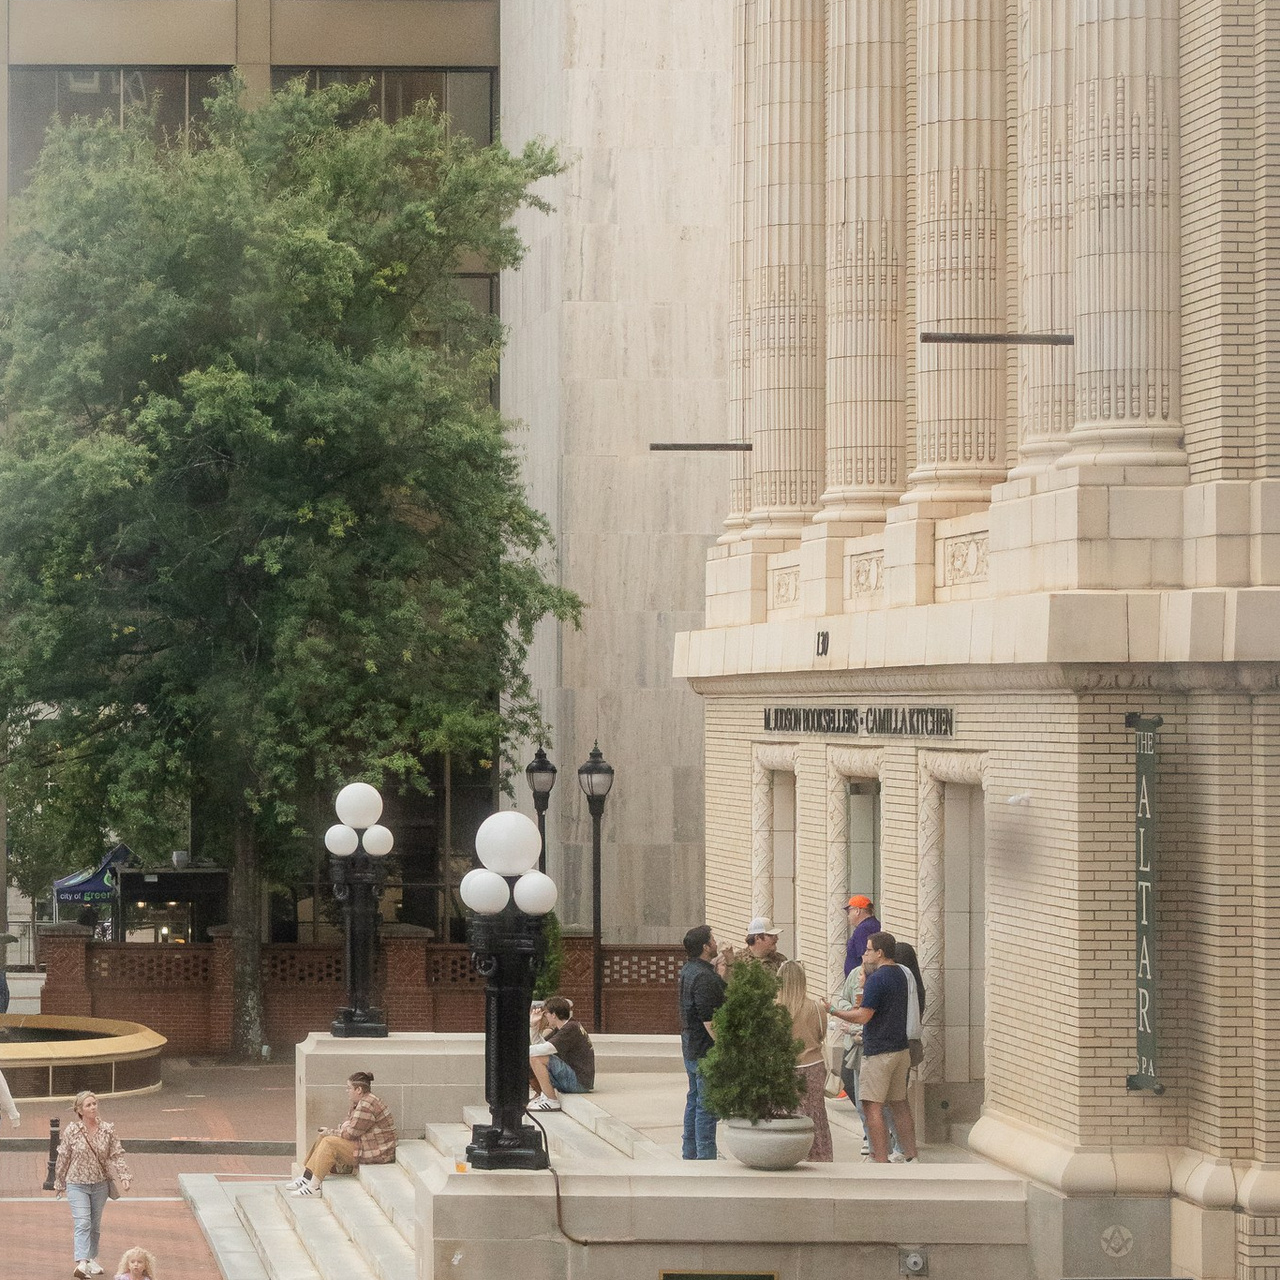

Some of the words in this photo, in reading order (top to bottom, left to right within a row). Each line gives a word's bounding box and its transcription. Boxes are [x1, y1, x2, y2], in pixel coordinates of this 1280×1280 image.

[816, 631, 829, 656] 130
[773, 708, 802, 732] JUDSON
[803, 708, 859, 734] BOOKSELLERS
[866, 708, 908, 735] CAMILLA
[908, 709, 954, 737] KITCHEN
[1136, 732, 1154, 754] THE
[1137, 775, 1152, 1034] ALTAR
